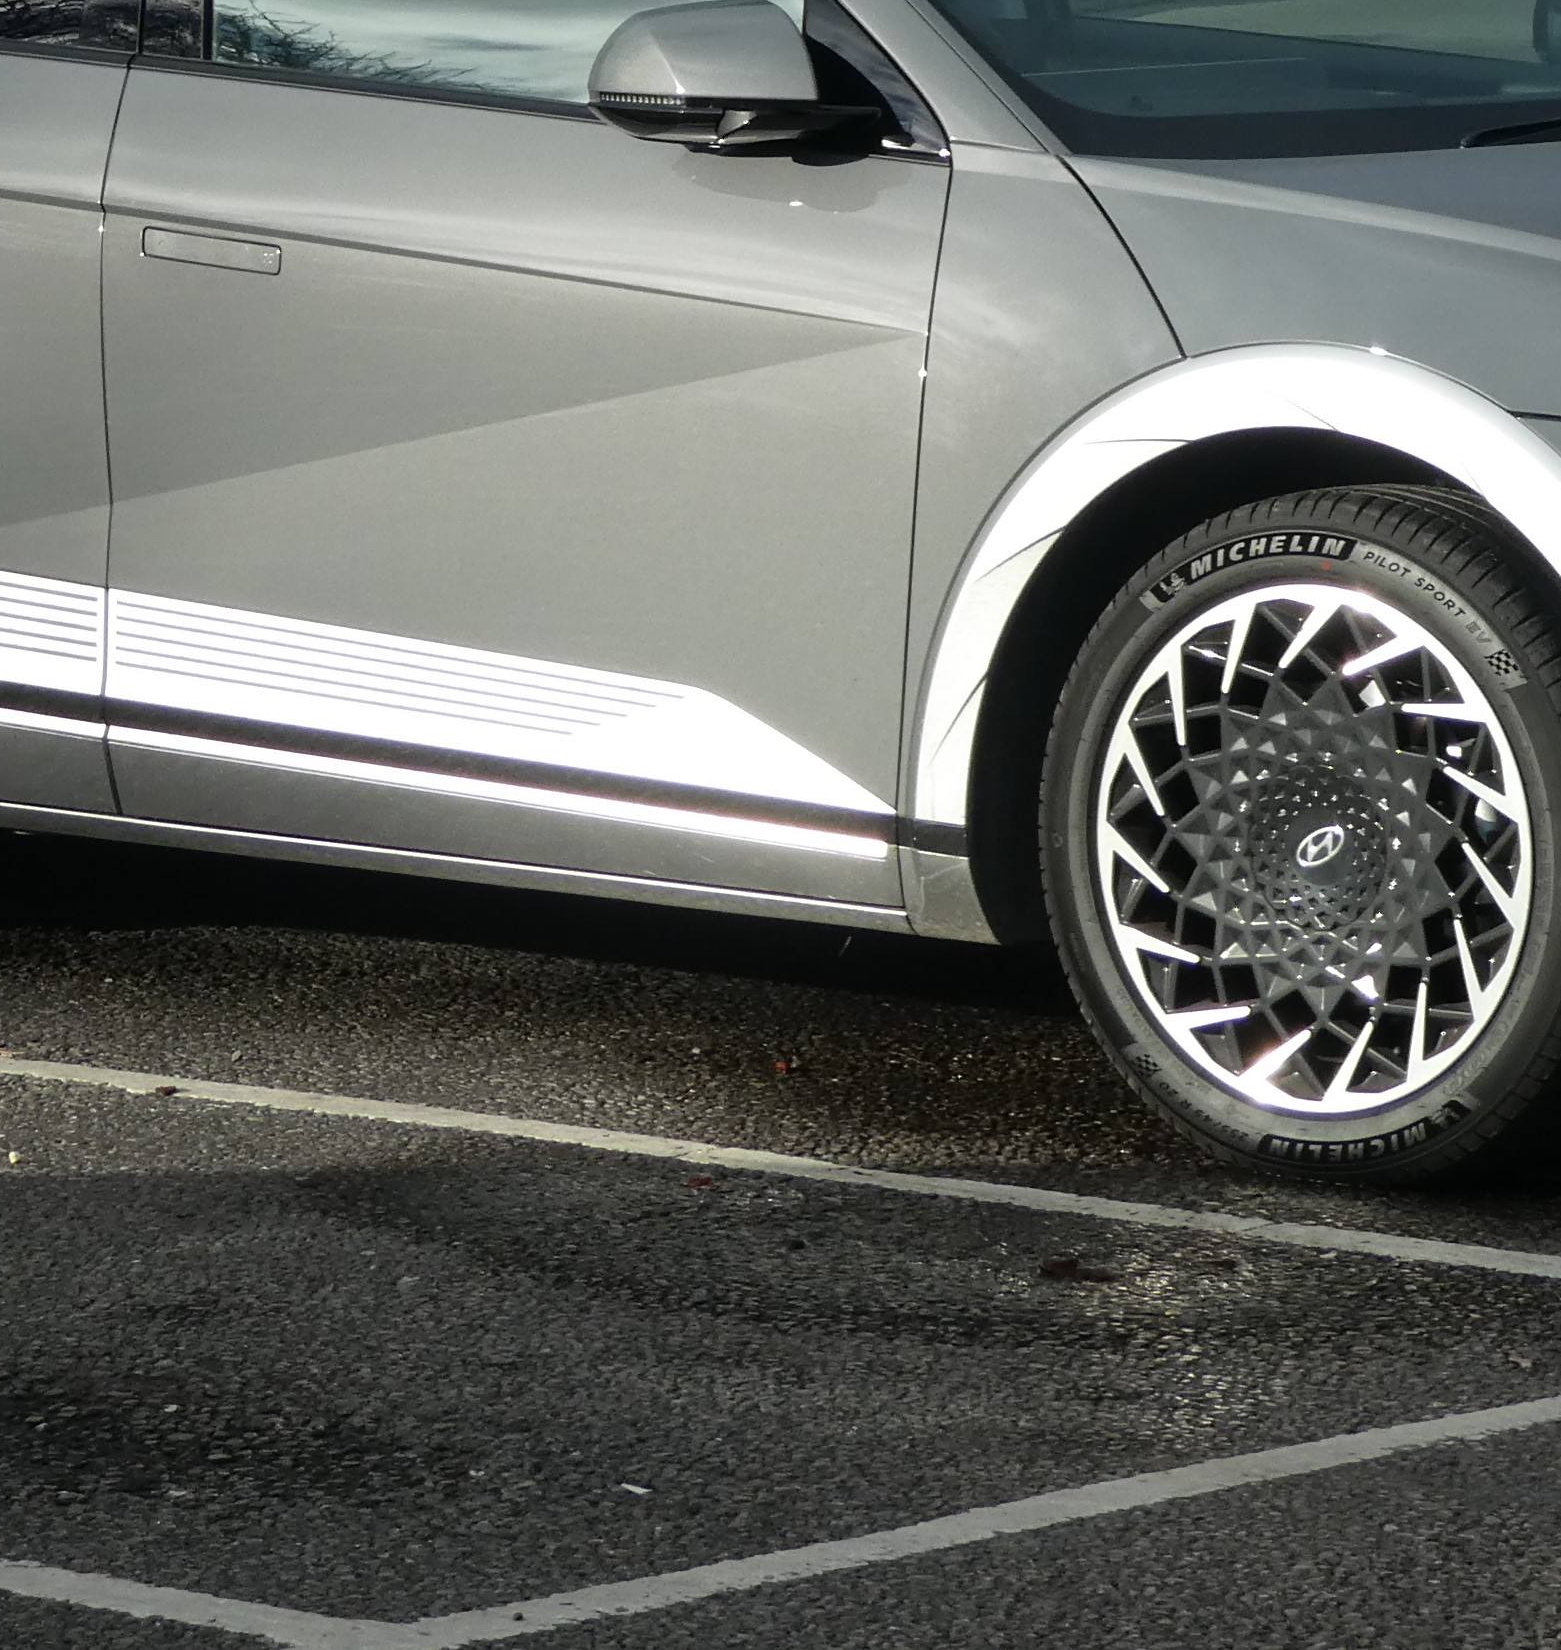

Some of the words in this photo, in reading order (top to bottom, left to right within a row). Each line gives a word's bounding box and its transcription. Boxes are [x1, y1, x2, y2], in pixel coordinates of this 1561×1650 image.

[1190, 534, 1346, 580] MICHELIN
[1362, 550, 1411, 578] PILOT
[1414, 577, 1466, 618] SPORT
[1465, 622, 1493, 644] EV
[1269, 1122, 1428, 1160] MICHELIN
